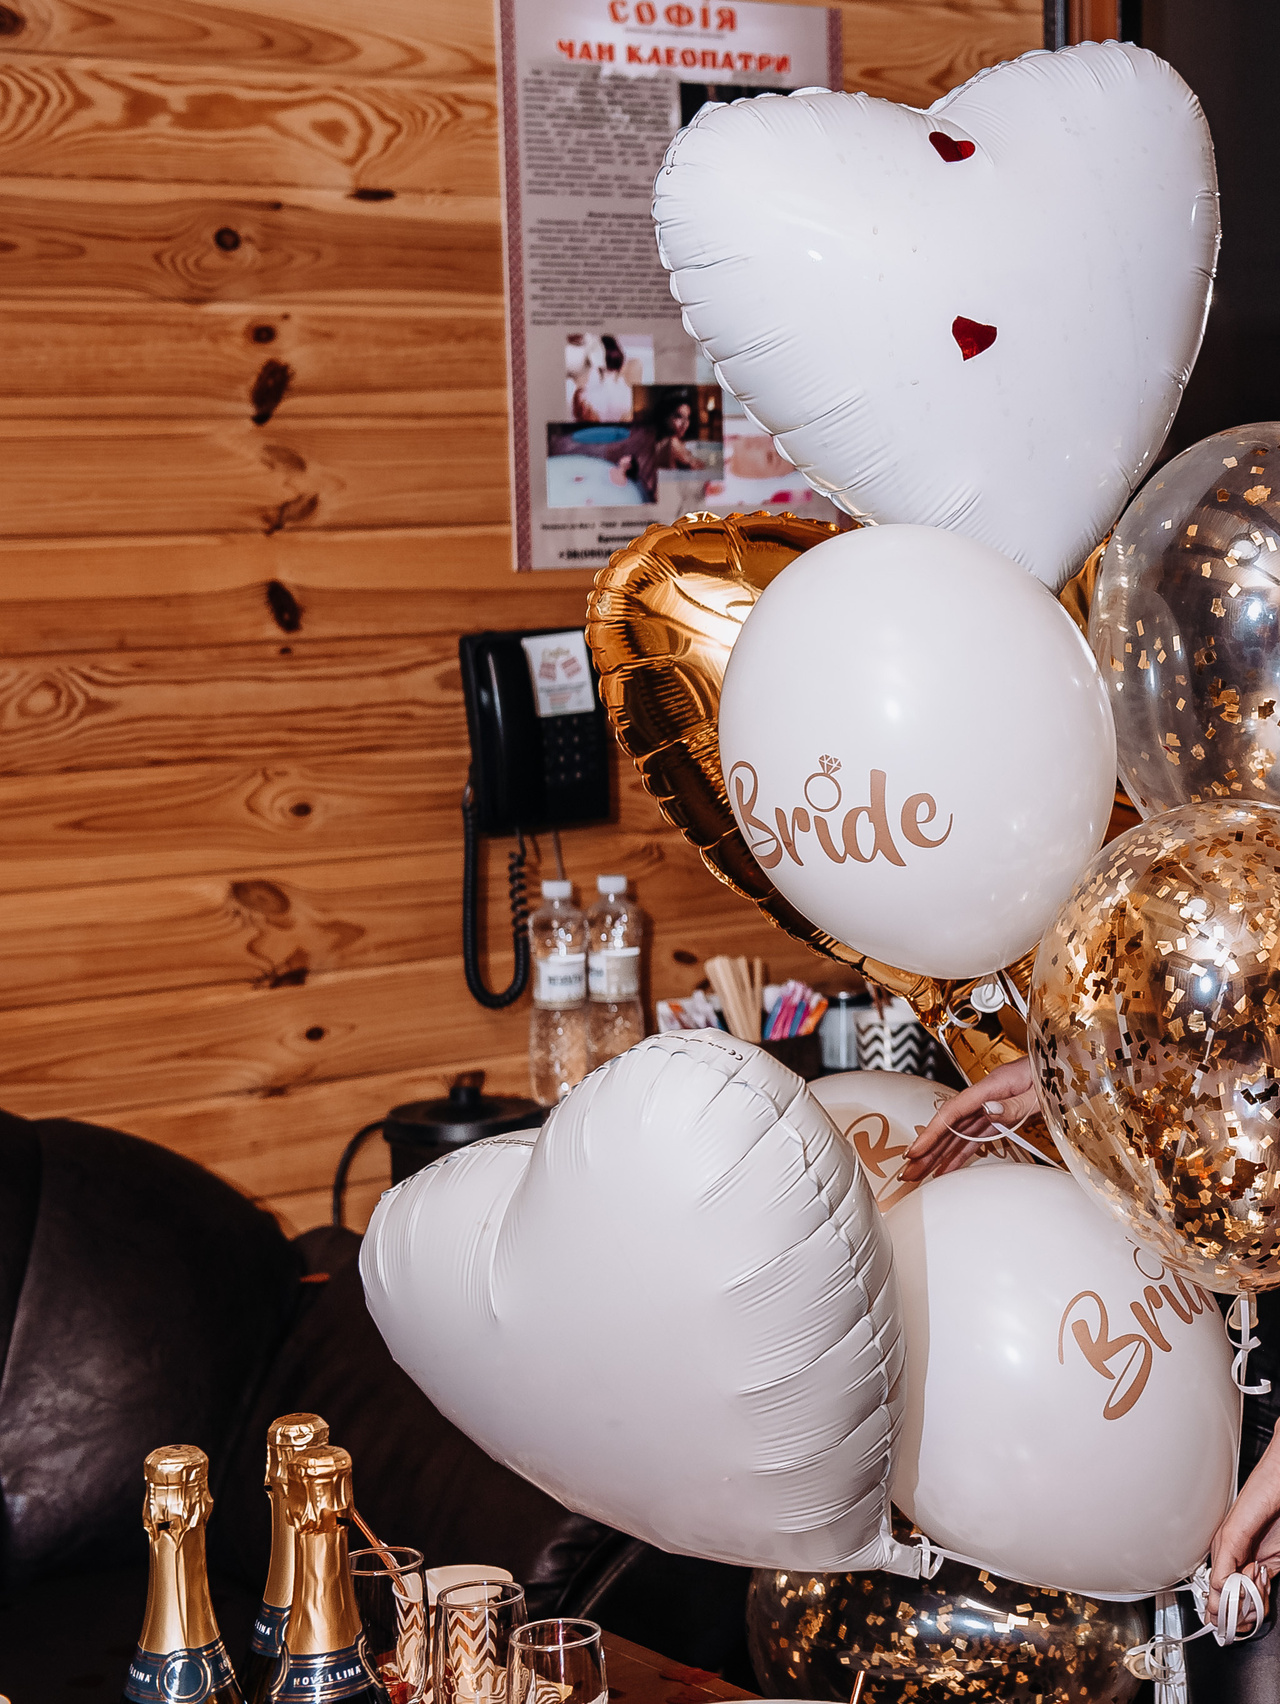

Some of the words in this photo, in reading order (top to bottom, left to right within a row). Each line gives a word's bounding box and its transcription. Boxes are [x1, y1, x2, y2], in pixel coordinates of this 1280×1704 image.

[609, 0, 736, 31] СОФІЯ
[557, 40, 614, 63] ЧАН
[626, 44, 791, 73] КЛЕОПАТРИ
[728, 758, 953, 869] Bride
[1058, 1262, 1214, 1421] Bri
[293, 1664, 362, 1687] NOVELLINA
